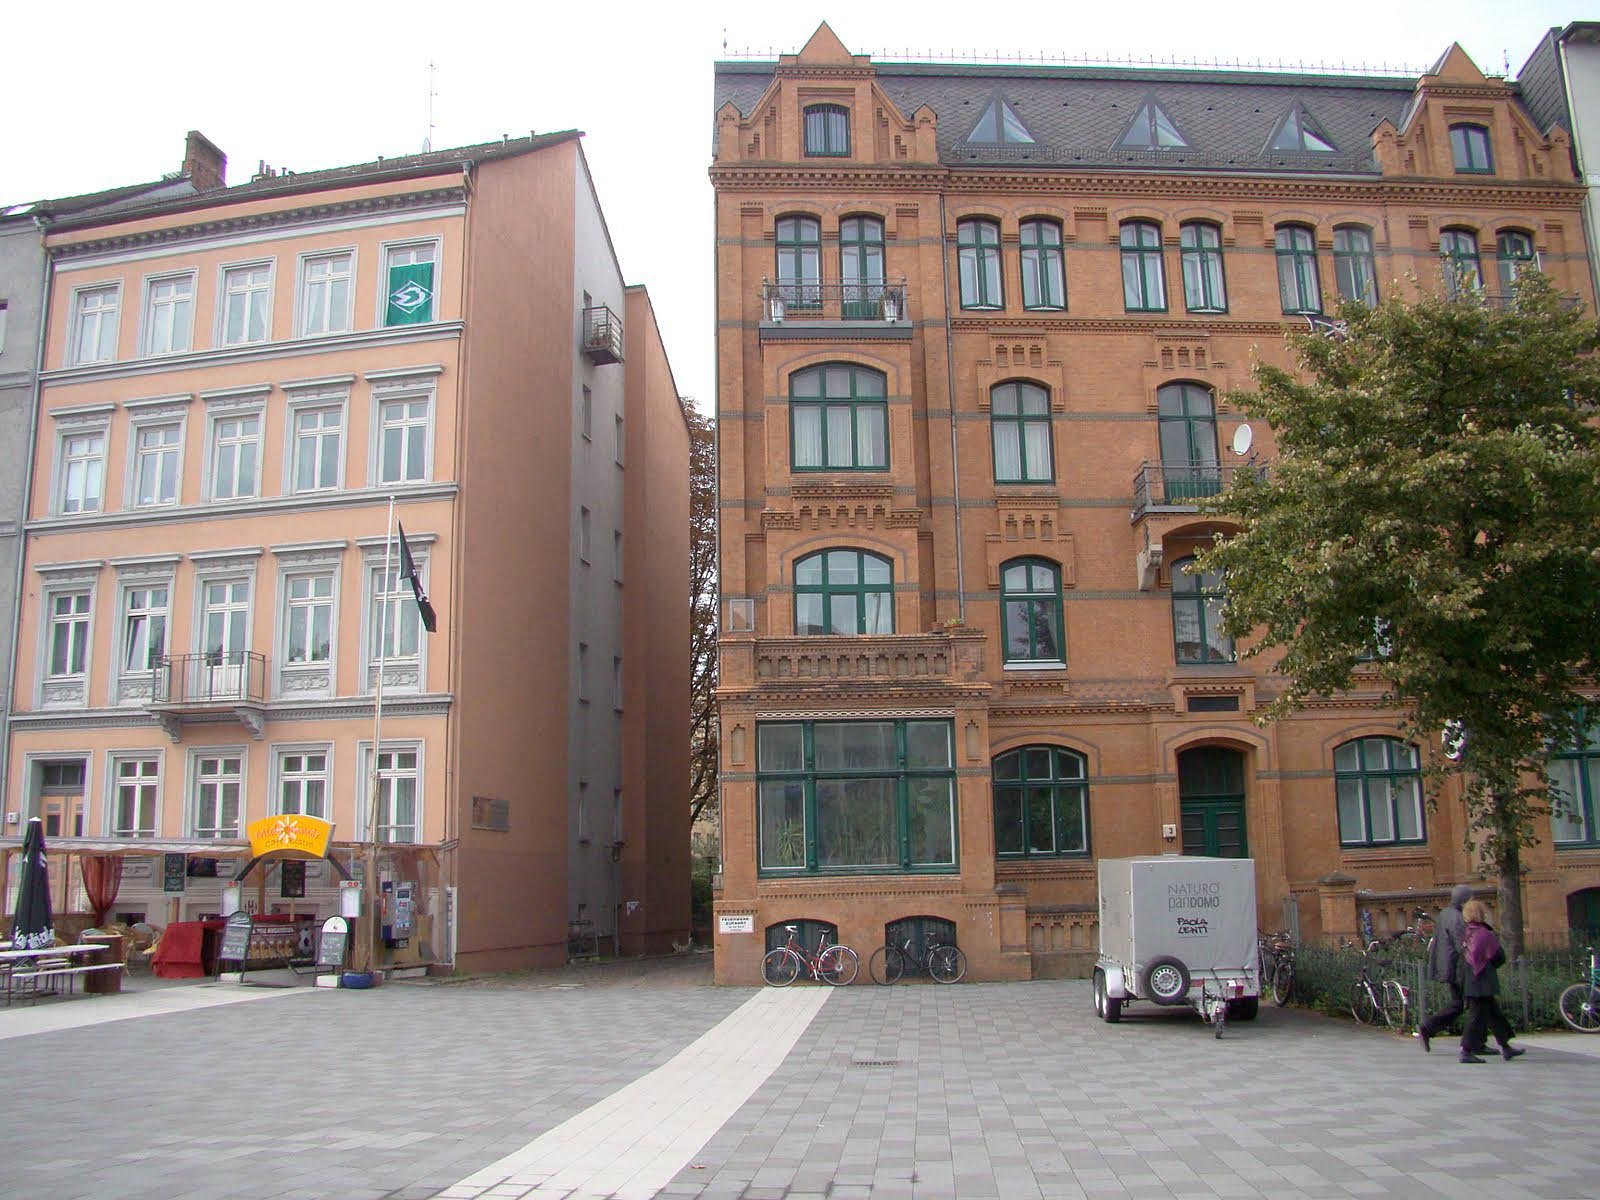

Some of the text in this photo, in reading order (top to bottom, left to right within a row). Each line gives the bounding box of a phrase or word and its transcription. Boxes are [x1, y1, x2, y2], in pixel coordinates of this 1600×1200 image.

[1168, 827, 1174, 835] 3
[1168, 882, 1220, 895] NATURO
[1169, 896, 1220, 912] panDOMO
[1177, 917, 1208, 926] PAOLA
